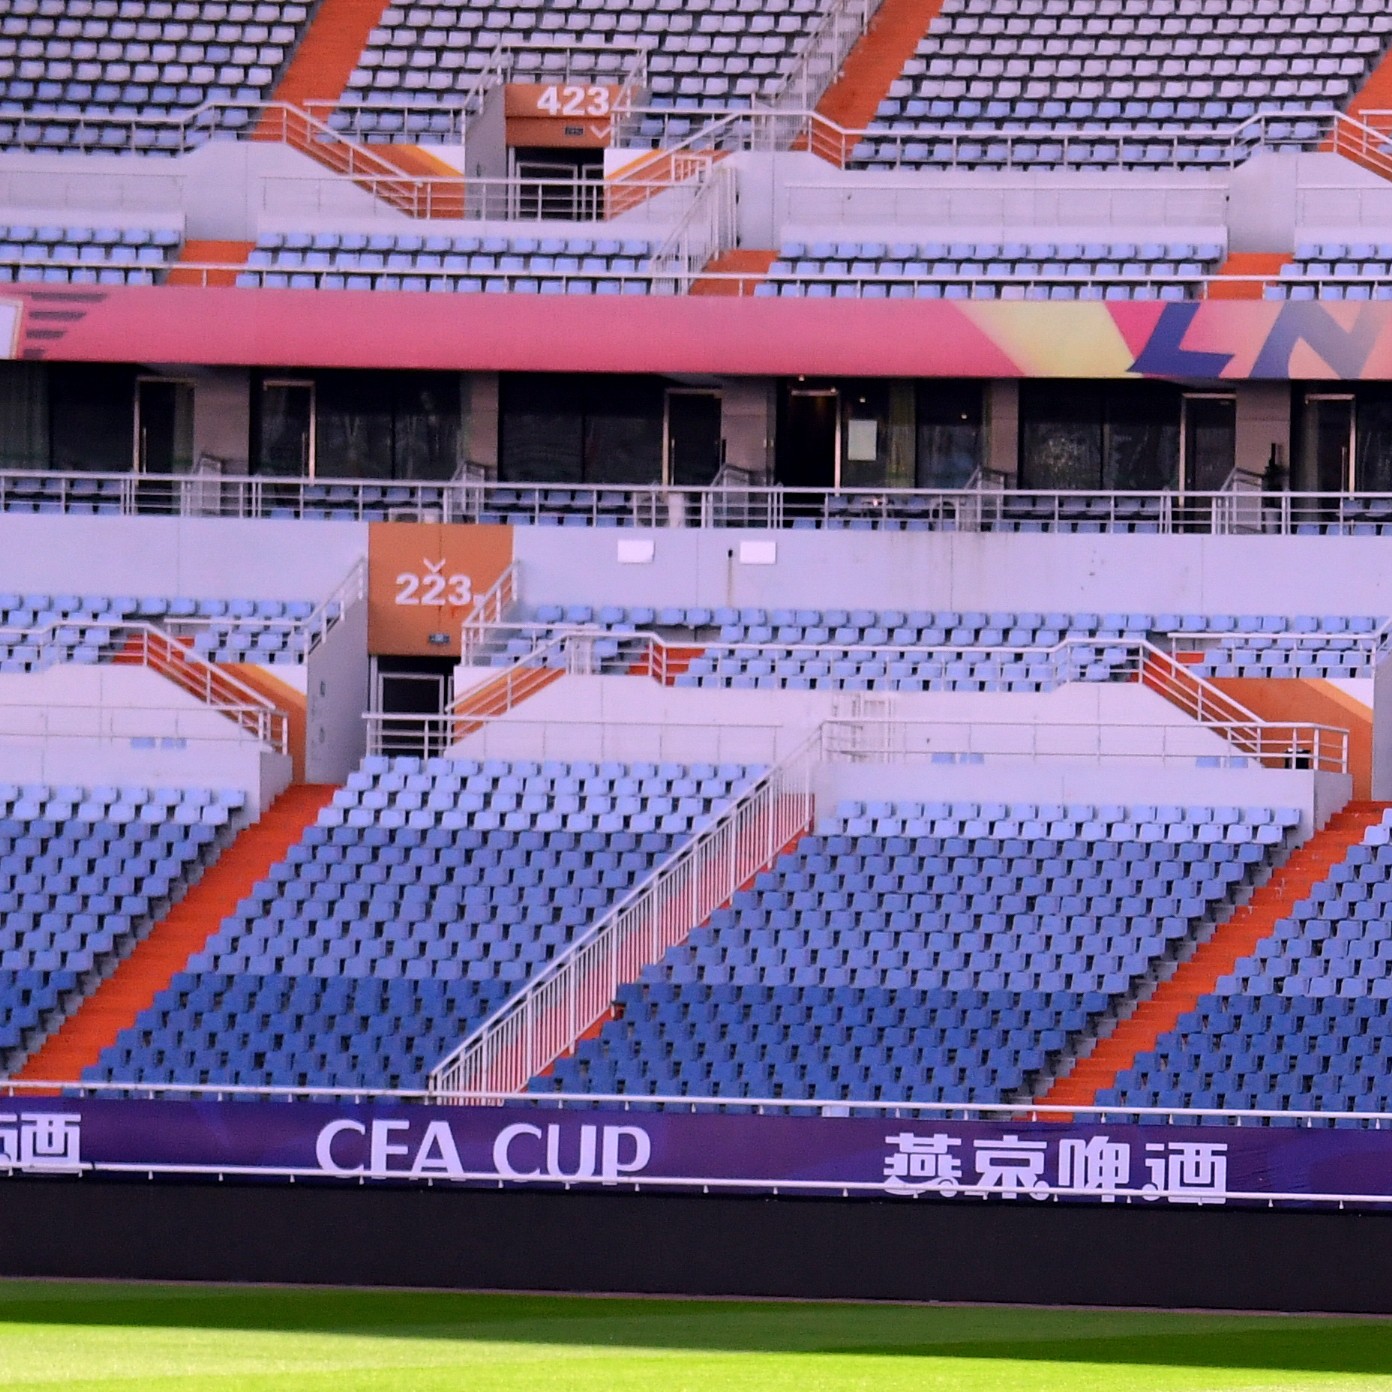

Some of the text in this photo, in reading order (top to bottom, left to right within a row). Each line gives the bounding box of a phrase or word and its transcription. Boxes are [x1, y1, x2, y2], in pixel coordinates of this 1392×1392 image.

[537, 86, 609, 116] 423
[395, 572, 472, 606] 223
[315, 1119, 651, 1185] CFA CUP
[883, 1132, 1228, 1205] 燕京啤酒
